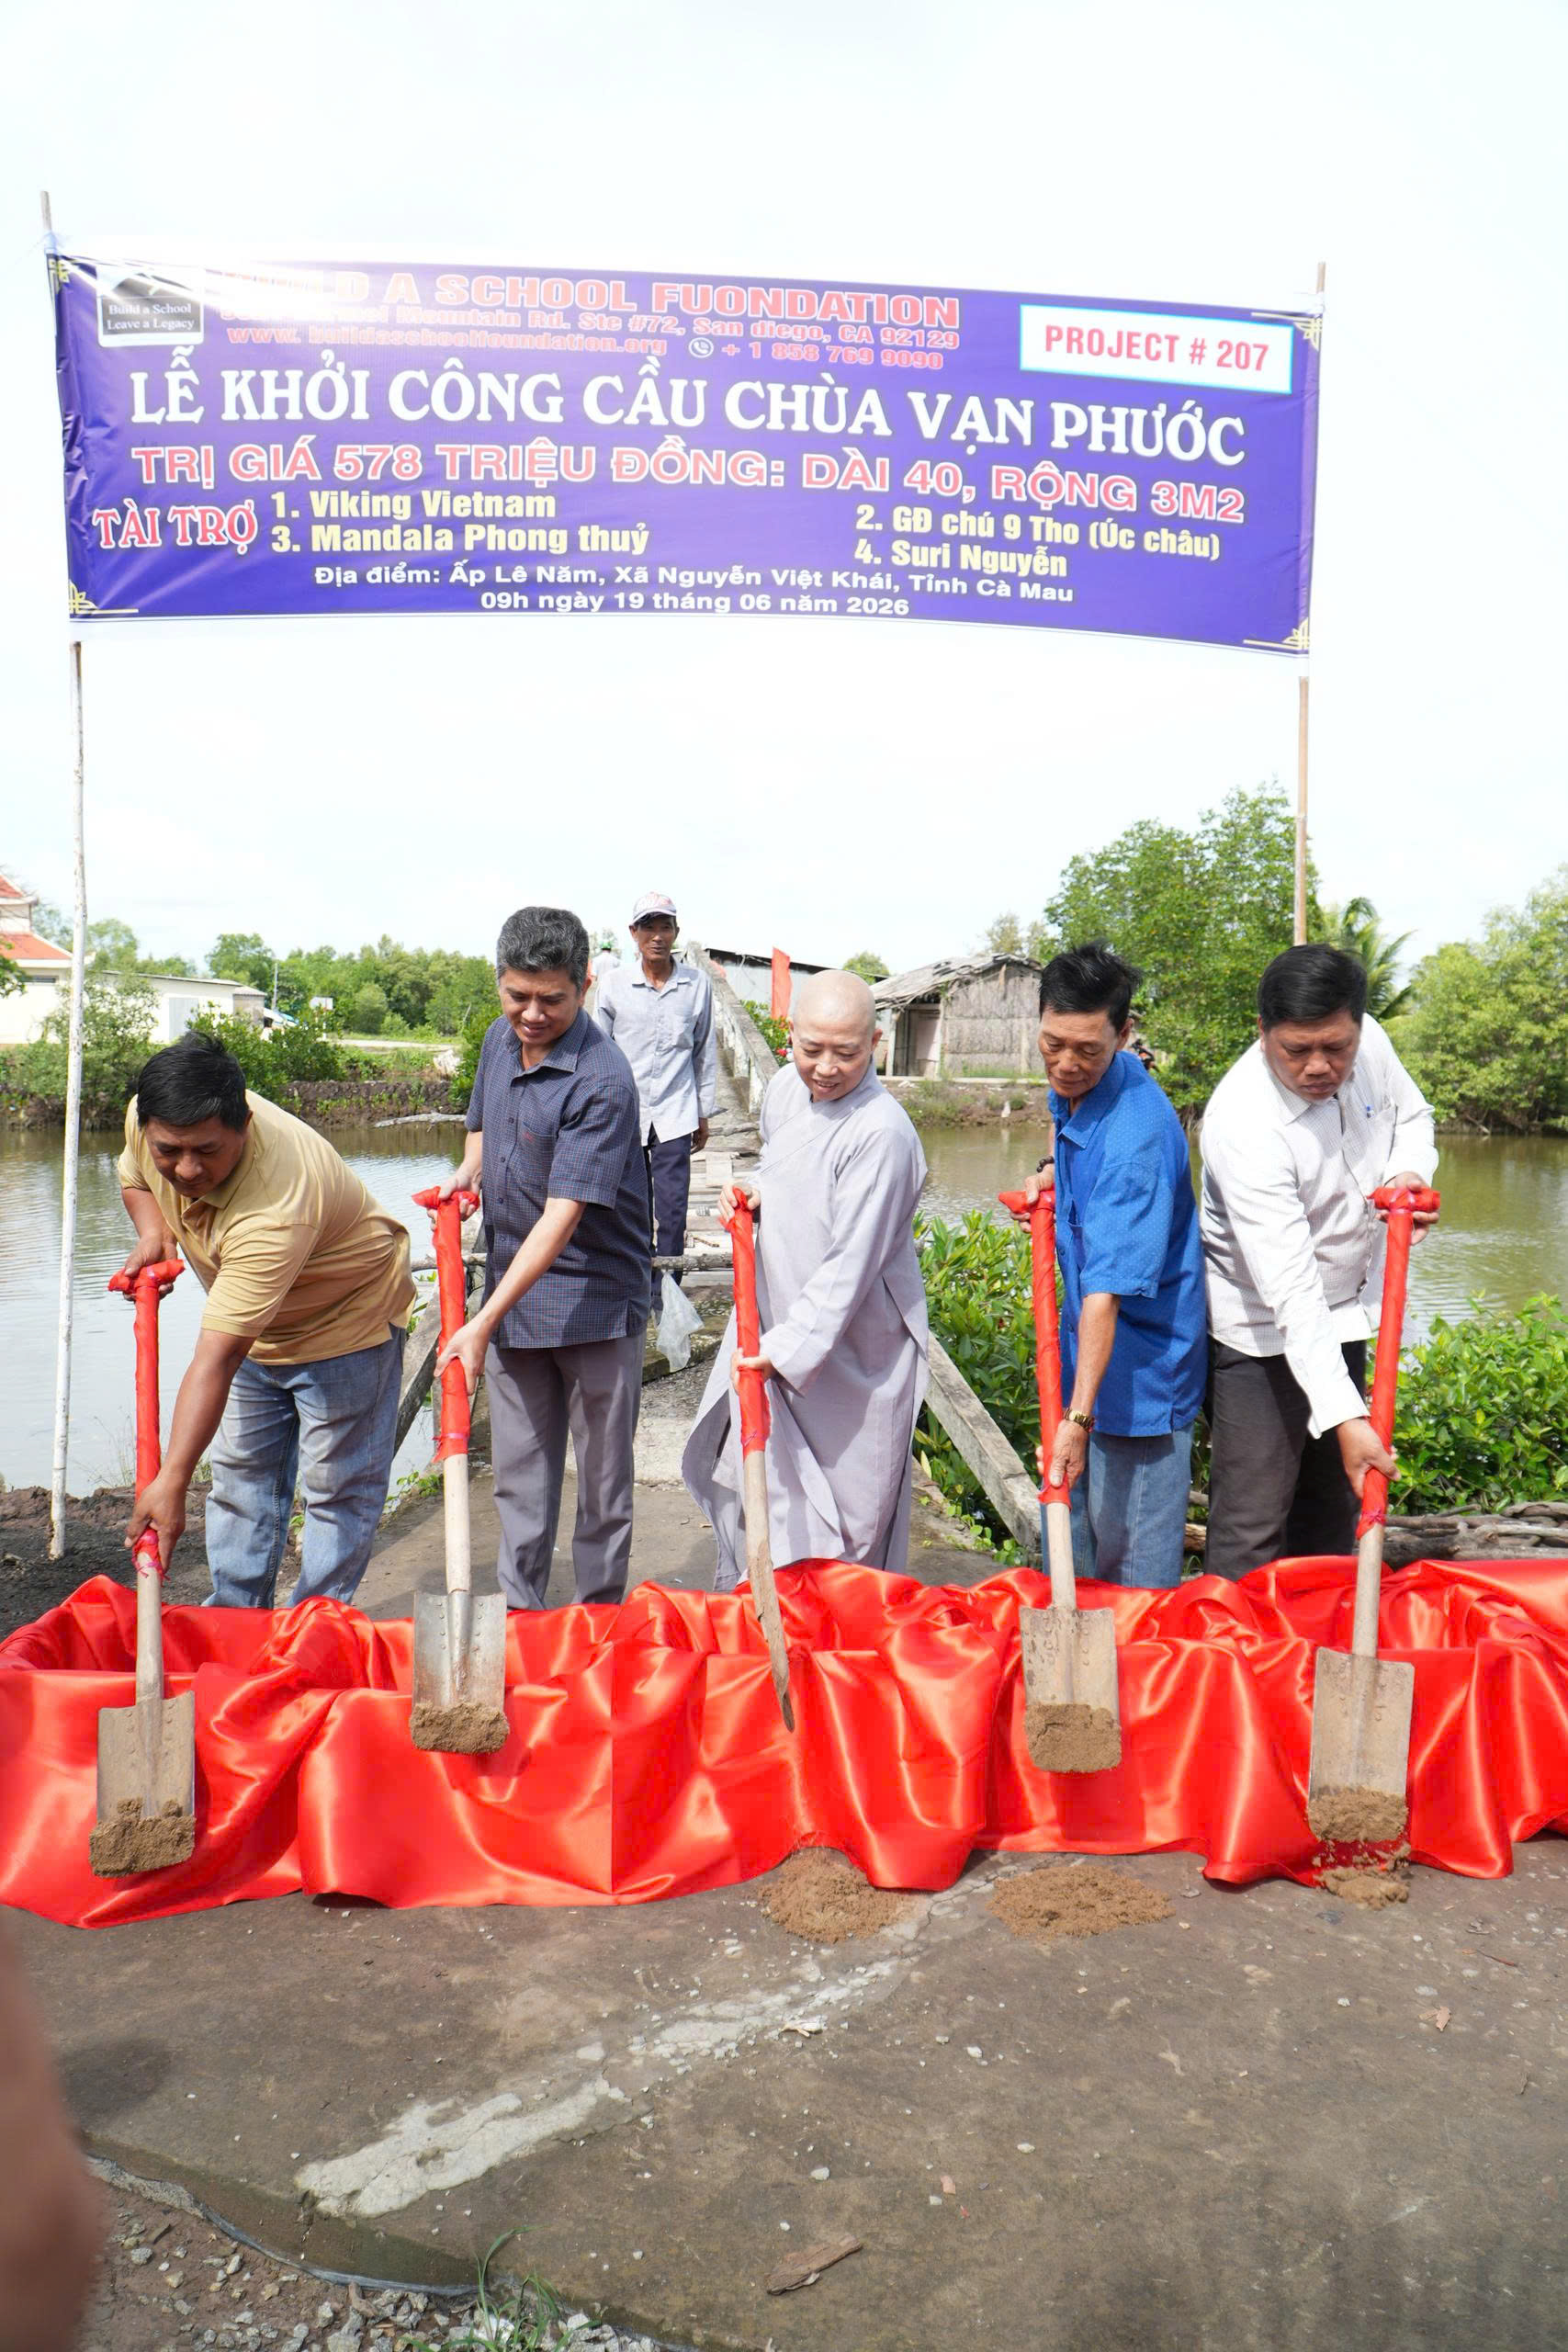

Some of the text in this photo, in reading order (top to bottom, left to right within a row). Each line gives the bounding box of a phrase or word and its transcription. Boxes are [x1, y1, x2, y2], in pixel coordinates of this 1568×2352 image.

[108, 304, 140, 314] Build
[152, 303, 191, 313] School
[382, 273, 421, 304] A
[434, 274, 637, 311] SCHOOL
[652, 281, 960, 329] FUONDATION
[107, 319, 140, 330] Leave
[152, 318, 195, 331] Legacy
[528, 311, 571, 329] Rd.
[579, 311, 623, 332] Ste
[629, 315, 686, 336] #72,
[694, 317, 743, 337] San
[750, 320, 831, 343] diego,
[839, 324, 874, 345] CA
[880, 327, 960, 350] 92129
[749, 341, 761, 359] 1
[772, 343, 820, 362] 858
[826, 345, 874, 365] 769
[880, 349, 943, 370] 9090
[1044, 324, 1269, 371] PROJECT # 207
[130, 345, 1246, 466] LỄ KHỞI CÔNG CẦU CHÙA VẠN PHƯỚC
[131, 435, 1245, 523] TRỊ GIÁ 578 TRIỆU ĐỒNG: DÀI 40, RỘNG 3M2
[271, 490, 557, 521] 1. Viking Vietnam
[92, 497, 258, 555] TÀI TRỢ
[271, 522, 649, 555] 3. Mandala Phong thuỷ
[855, 504, 1220, 560] 2. GĐ chú 9 Tho (Úc châu)
[854, 538, 1067, 577] 4. Suri Nguyễn
[315, 559, 1074, 603] Địa điểm: Ấp Lê Năm, Xã Nguyễn Việt Khái, Tỉnh Cà Mau
[480, 591, 910, 616] 09h ngày 19 tháng 06 năm 2026
